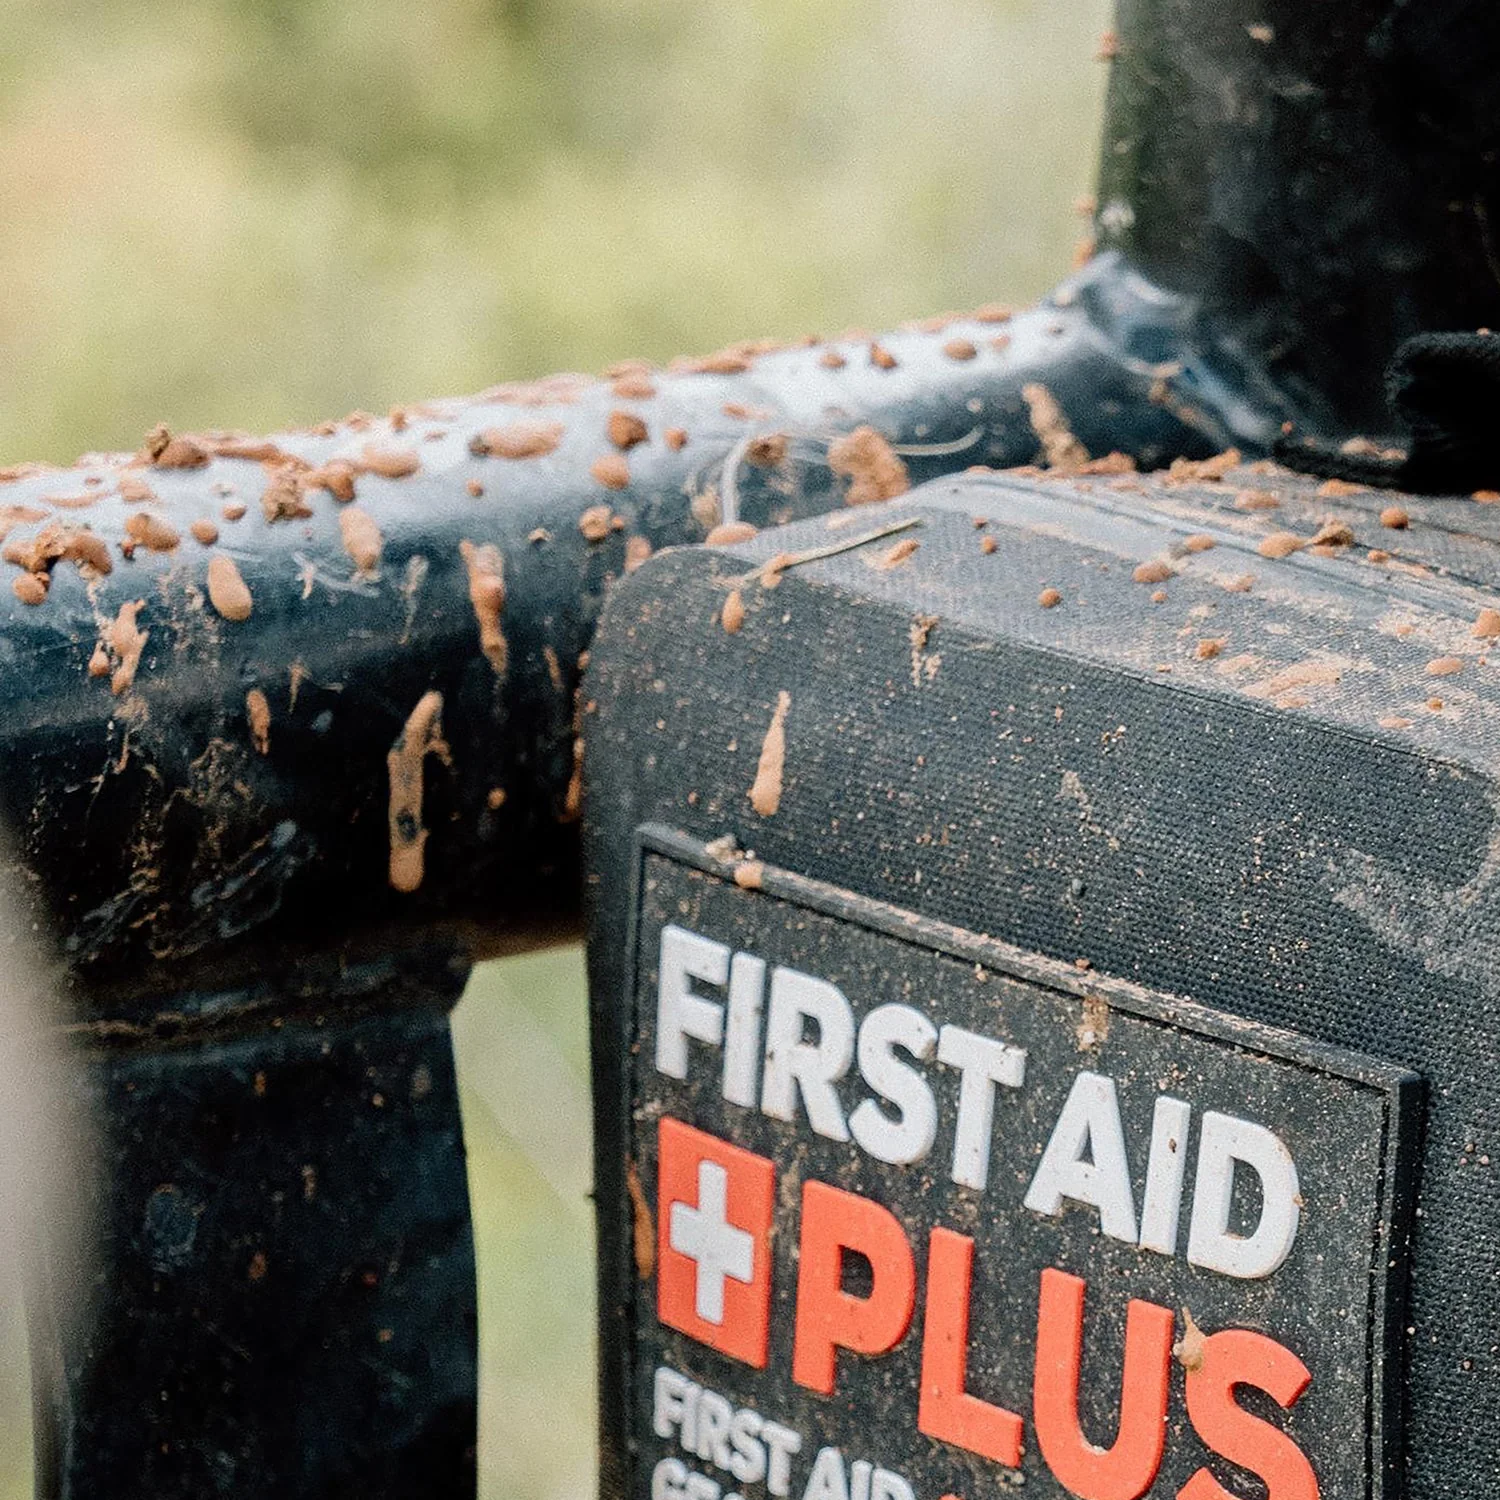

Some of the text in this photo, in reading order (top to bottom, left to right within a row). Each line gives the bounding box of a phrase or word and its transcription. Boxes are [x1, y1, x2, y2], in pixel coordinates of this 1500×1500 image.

[655, 925, 1300, 1279] FIRST AID
[653, 1367, 800, 1496] FIRST
